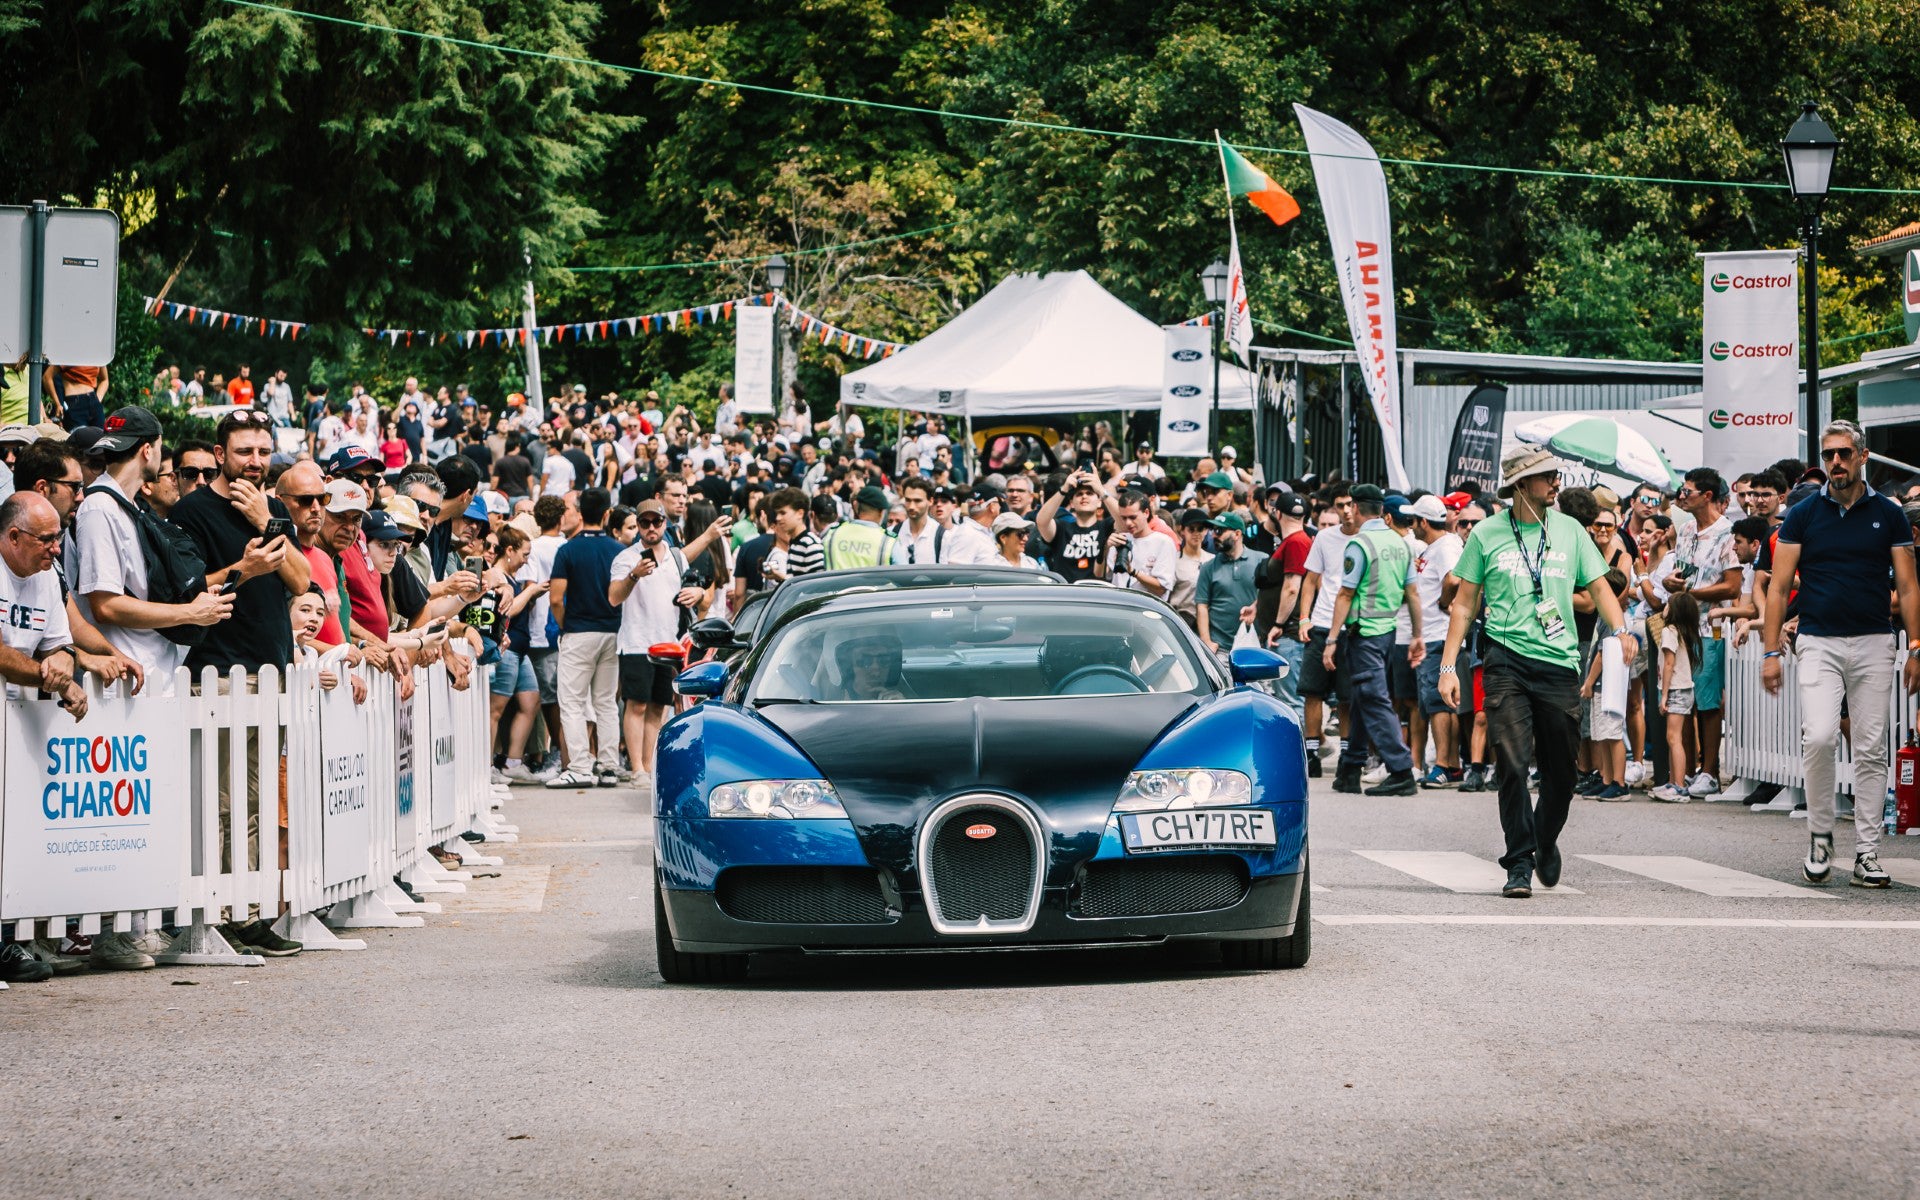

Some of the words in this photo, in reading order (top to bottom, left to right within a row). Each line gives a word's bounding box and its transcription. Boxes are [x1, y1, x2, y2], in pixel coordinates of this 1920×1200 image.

[1732, 274, 1792, 289] Castrol
[1732, 343, 1793, 358] Castrol
[1731, 412, 1793, 426] Castrol
[1457, 456, 1492, 474] PUZZLE
[1070, 530, 1099, 547] JUST
[838, 540, 872, 555] GNR
[1381, 544, 1407, 561] GNR
[46, 734, 147, 776] STRONG
[42, 779, 151, 820] CHARON
[328, 784, 364, 816] CARAMULO
[46, 839, 88, 856] SOLUÇÕES
[89, 840, 100, 852] DE
[101, 838, 147, 853] SEGURANÇA
